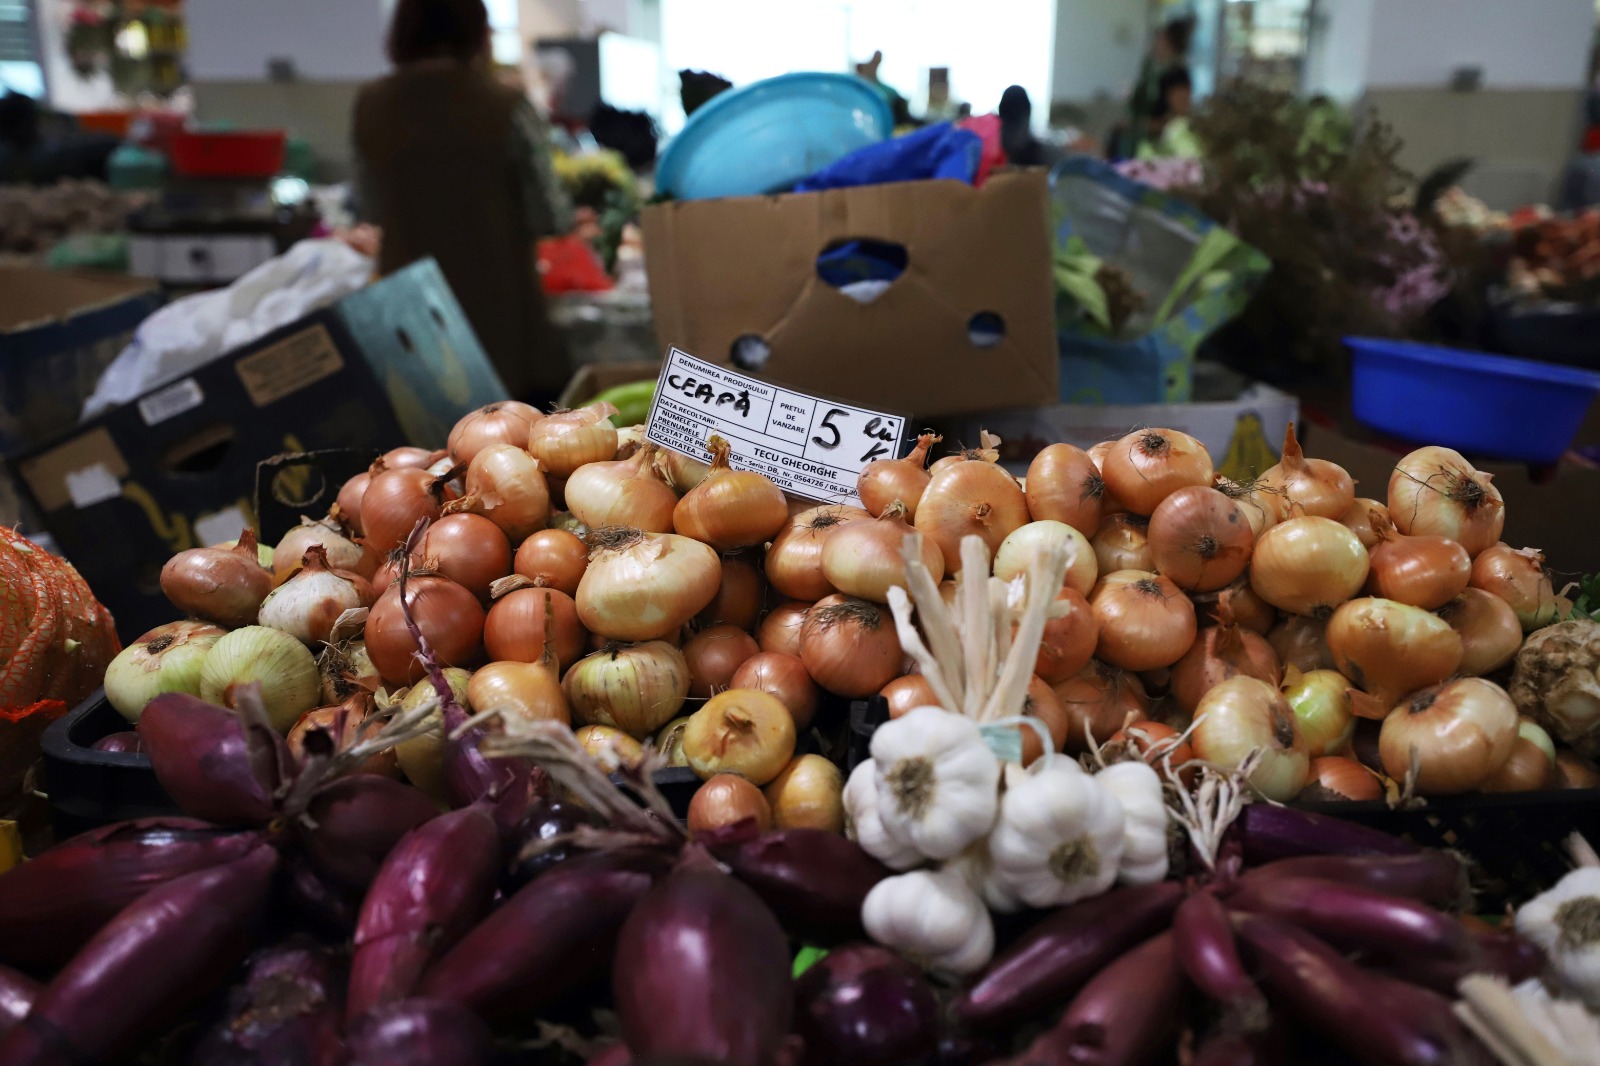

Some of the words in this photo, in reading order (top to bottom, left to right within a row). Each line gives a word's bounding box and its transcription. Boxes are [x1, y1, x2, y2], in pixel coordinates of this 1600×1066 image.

[679, 358, 720, 379] DENUMIREA
[723, 376, 768, 396] PRODUSULUI
[660, 398, 678, 411] DATA
[678, 406, 715, 425] RECOLTARII
[662, 409, 691, 426] NUMELE
[780, 402, 806, 415] PRETUL
[786, 413, 796, 422] DE
[657, 416, 700, 438] PRENUMELE
[772, 419, 805, 434] VANZARE
[812, 408, 850, 451] 5
[650, 430, 696, 454] LOCALITATEA
[653, 422, 683, 439] ATESTAT
[684, 435, 694, 444] DE
[749, 460, 766, 471] Seria:
[793, 473, 824, 488] 0564726
[754, 447, 779, 462] TECU
[781, 457, 837, 480] GHEORGHE
